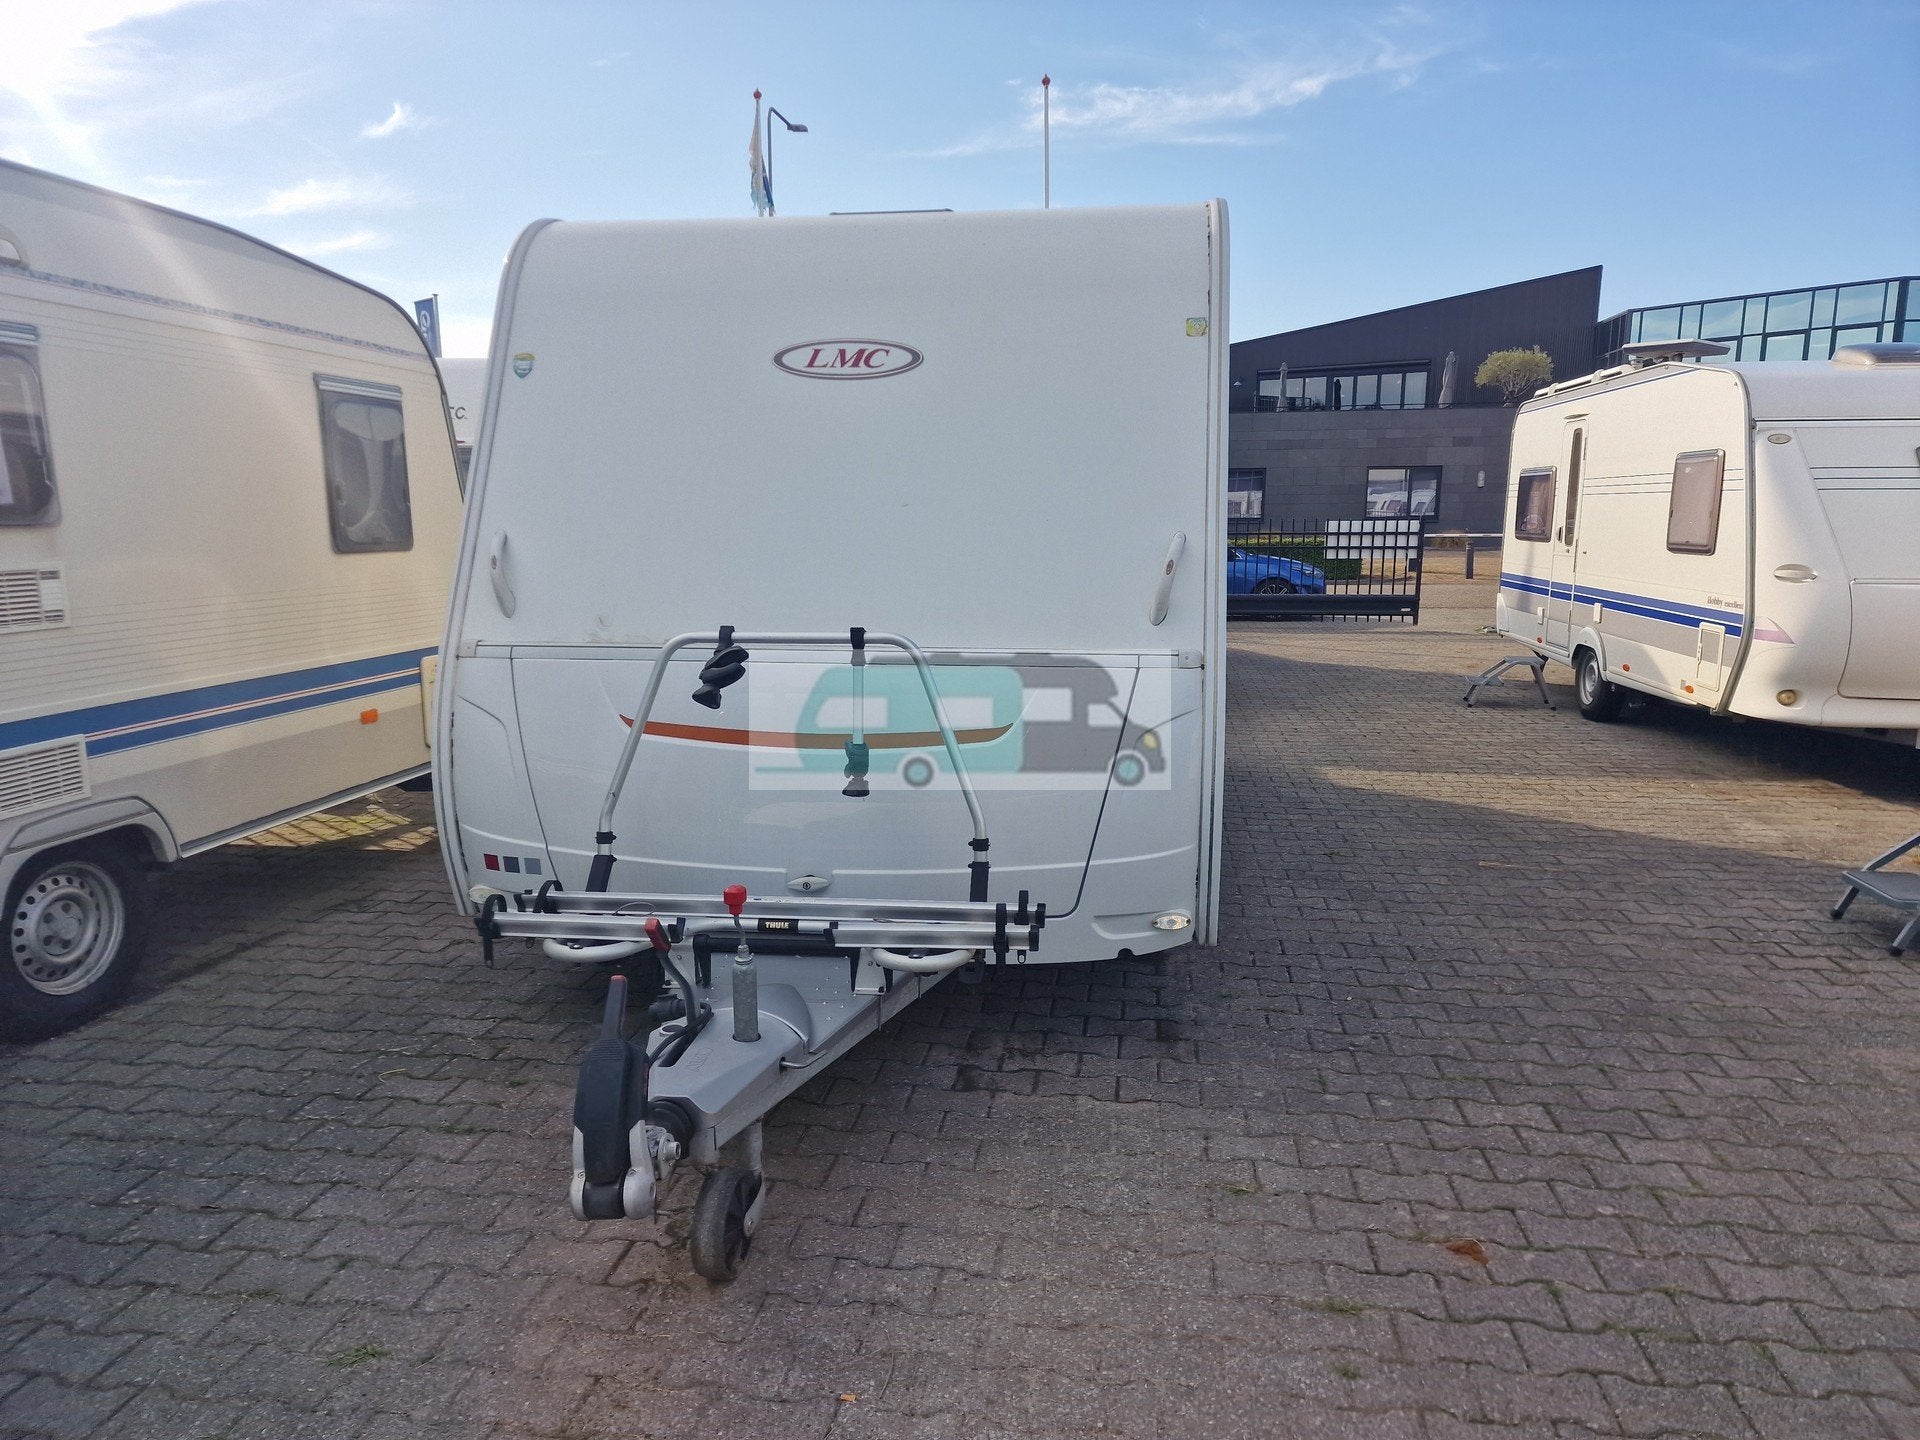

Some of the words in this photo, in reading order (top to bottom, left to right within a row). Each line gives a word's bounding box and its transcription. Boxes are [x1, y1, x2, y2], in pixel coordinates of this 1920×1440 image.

[804, 348, 892, 369] LMC
[1707, 596, 1723, 608] Hobby
[765, 921, 790, 929] THULE
